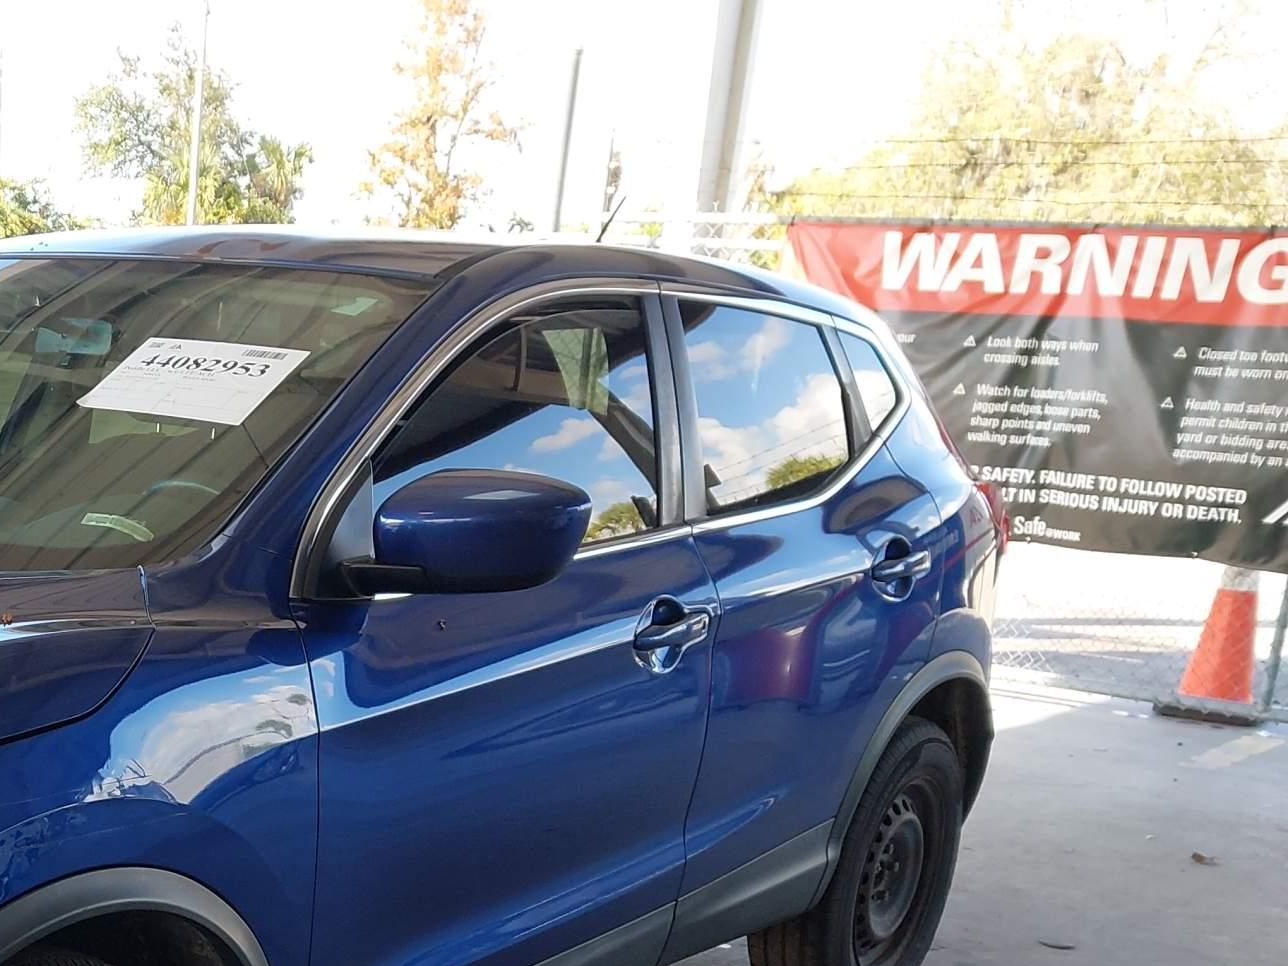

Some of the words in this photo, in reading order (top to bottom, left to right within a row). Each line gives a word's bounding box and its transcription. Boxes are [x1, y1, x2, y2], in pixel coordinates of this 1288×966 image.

[881, 230, 1288, 304] WARNING
[987, 336, 1012, 348] Look
[1015, 337, 1039, 350] both
[1041, 340, 1067, 352] ways
[1069, 340, 1099, 353] when
[984, 353, 1028, 367] crossing
[1198, 346, 1238, 360] Closed
[1239, 350, 1258, 362] toe
[141, 353, 271, 378] 44082953
[1194, 366, 1223, 377] must
[1224, 366, 1239, 378] be
[1241, 368, 1272, 379] worn
[977, 384, 1011, 397] Watch
[1013, 386, 1029, 398] for
[972, 400, 1008, 415] jagged
[1070, 406, 1101, 420] parts,
[1185, 398, 1221, 411] Health
[1222, 401, 1245, 413] and
[1245, 403, 1283, 418] safety
[970, 416, 999, 429] sharp
[1001, 417, 1034, 430] points
[1052, 421, 1091, 434] uneven
[1180, 416, 1216, 428] permit
[1218, 417, 1263, 431] children
[1265, 421, 1276, 432] in
[968, 431, 1007, 446] walking
[1177, 432, 1203, 445] yard
[1205, 434, 1218, 444] or
[1220, 433, 1264, 451] bidding
[1172, 448, 1248, 463] accompanied
[1250, 453, 1266, 468] by
[1267, 456, 1282, 467] an
[982, 466, 1036, 484] SAFETY.
[1039, 470, 1095, 489] FAILURE
[1098, 475, 1117, 491] TO
[1120, 478, 1183, 498] FOLLOW
[1185, 484, 1247, 505] POSTED
[1018, 488, 1036, 503] IN
[1039, 489, 1099, 510] SERIOUS
[1102, 495, 1157, 516] INJURY
[1162, 502, 1182, 517] OR
